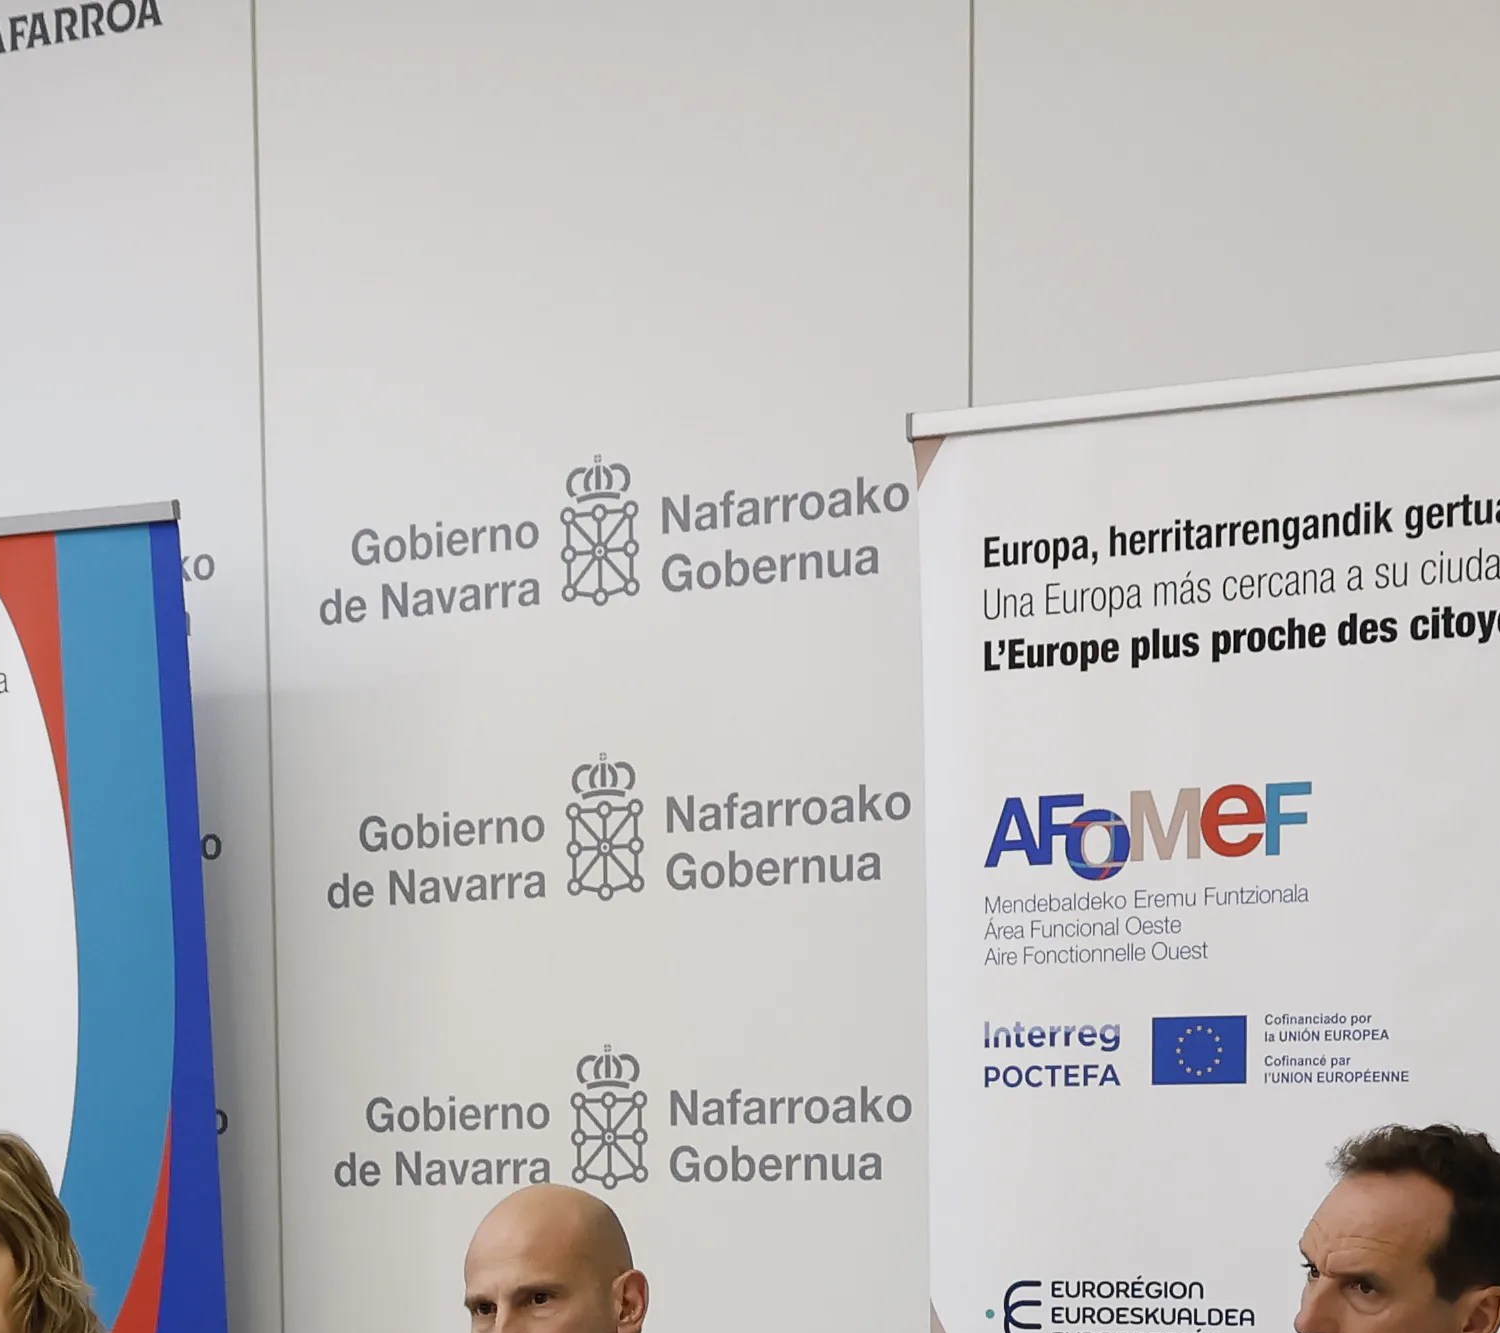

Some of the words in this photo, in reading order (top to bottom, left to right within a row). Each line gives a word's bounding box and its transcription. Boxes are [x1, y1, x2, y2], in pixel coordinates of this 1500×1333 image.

[660, 477, 910, 534] Nafarroako
[351, 515, 540, 566] Gobierno
[983, 533, 1099, 569] Europa,
[1108, 502, 1394, 558] herritarrengandik
[661, 543, 880, 593] Gobernua
[319, 589, 367, 625] de
[381, 574, 541, 621] Navarra
[983, 587, 1035, 621] Una
[1045, 583, 1142, 618] Europa
[1153, 571, 1211, 607] más
[1222, 565, 1335, 602] cercana
[1347, 566, 1363, 591] a
[1374, 562, 1410, 588] su
[1130, 627, 1200, 669] plus
[1211, 619, 1327, 661] proche
[1336, 611, 1398, 646] des
[666, 785, 911, 835] Nafarroako
[359, 812, 545, 853] Gobierno
[666, 844, 882, 892] Gobernua
[327, 874, 374, 910] de
[388, 867, 546, 905] Navarra
[984, 892, 1126, 915] Mendebaldeko
[1134, 888, 1196, 909] Eremu
[1204, 884, 1309, 906] Funtzionala
[984, 918, 1025, 939] Área
[1030, 917, 1119, 938] Funcional
[1125, 915, 1181, 935] Oeste
[984, 947, 1017, 966] Aire
[1023, 943, 1146, 965] Fonctionnelle
[1152, 941, 1208, 961] Ouest
[984, 1021, 1120, 1052] Interreg
[1264, 1014, 1345, 1026] Cofinanciado
[1350, 1015, 1372, 1028] por
[1264, 1029, 1274, 1042] la
[1279, 1027, 1320, 1043] UNIÓN
[1324, 1029, 1389, 1041] EUROPEA
[984, 1064, 1120, 1088] POCTEFA
[1264, 1054, 1327, 1068] Cofinancé
[1330, 1056, 1351, 1069] par
[1316, 1068, 1409, 1083] EUROPÉENNE
[366, 1096, 550, 1133] Gobierno
[669, 1086, 911, 1127] Nafarroako
[334, 1152, 380, 1188] de
[394, 1149, 551, 1188] Navarra
[669, 1144, 883, 1183] Gobernua
[1051, 1276, 1204, 1300] EURORÉGION
[1051, 1306, 1255, 1326] EUROESKUALDEA
